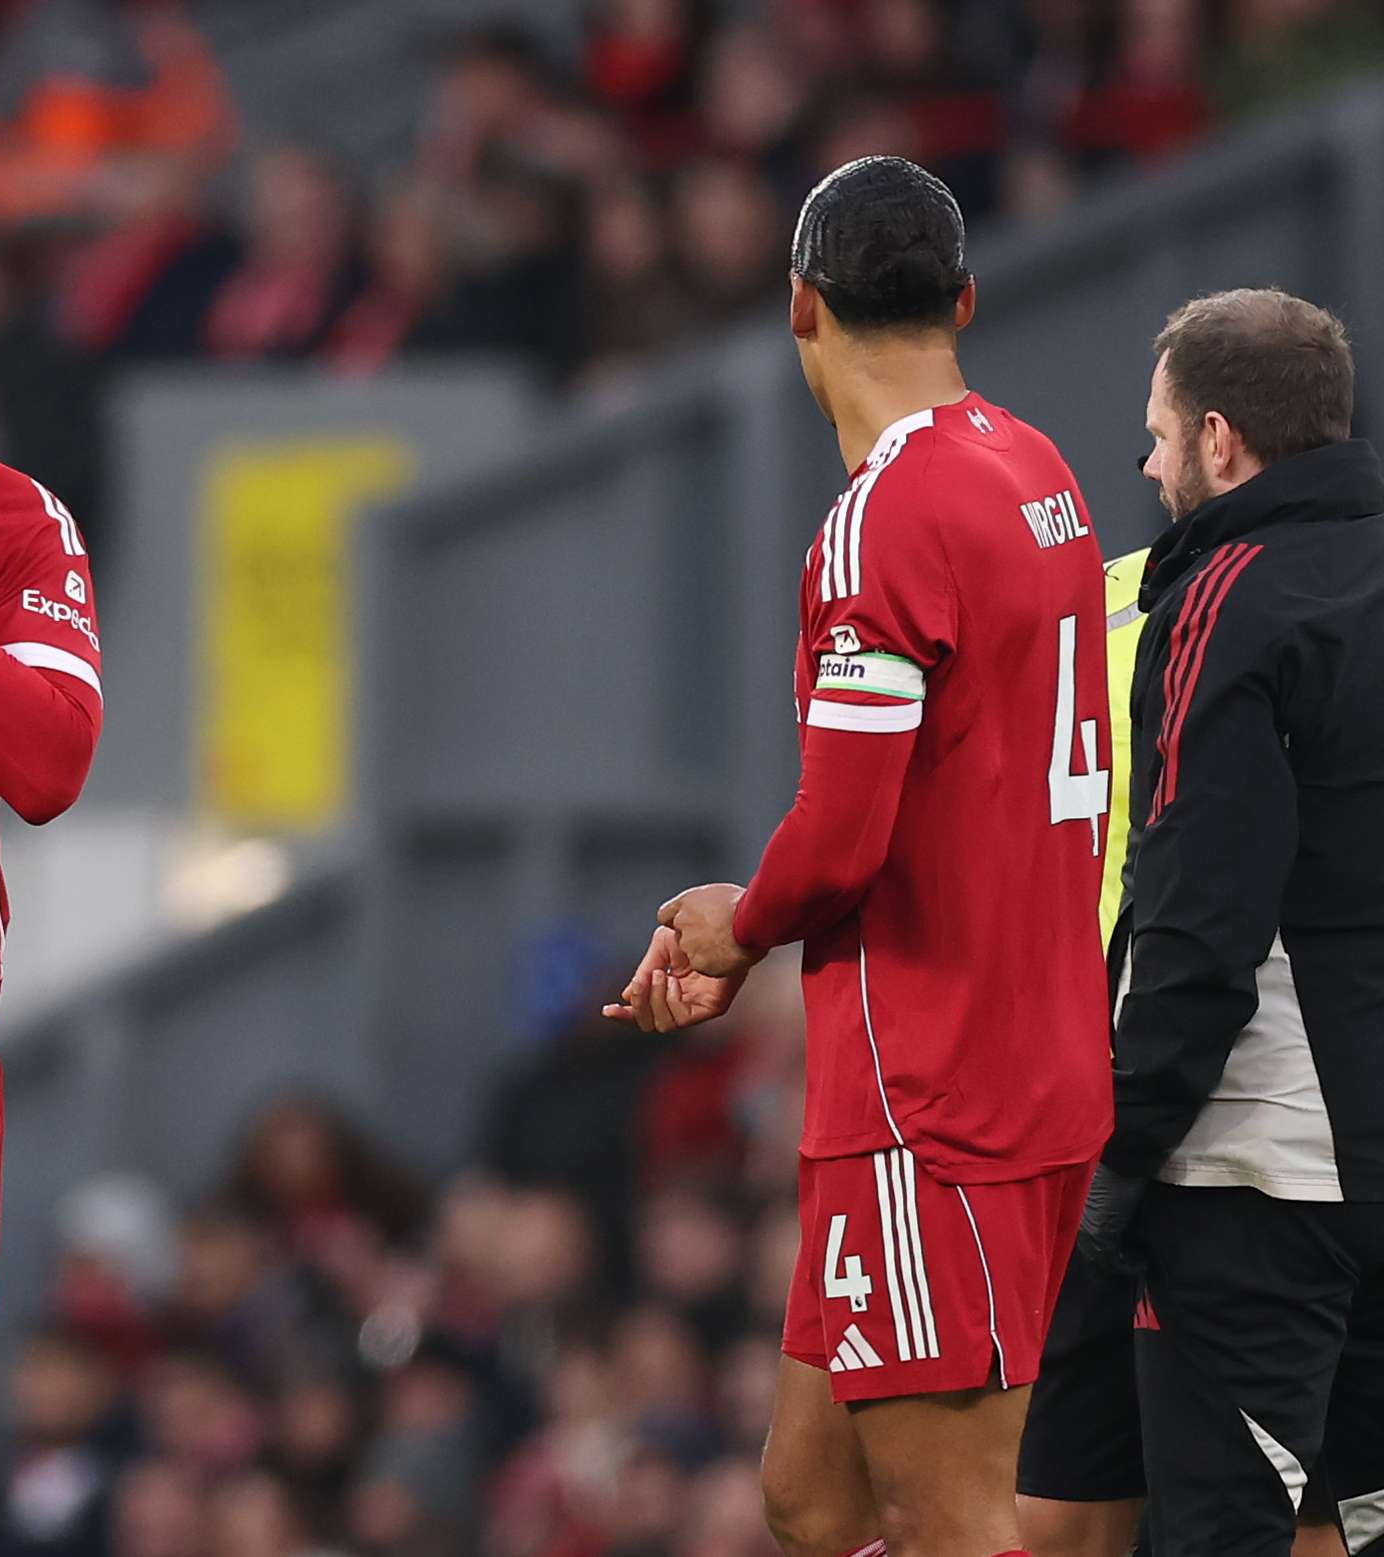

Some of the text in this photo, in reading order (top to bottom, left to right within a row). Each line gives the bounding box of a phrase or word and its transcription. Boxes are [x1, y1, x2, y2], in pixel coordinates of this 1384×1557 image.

[1020, 489, 1089, 549] VIRGIL
[1048, 615, 1110, 857] 4
[824, 1214, 873, 1313] 4
